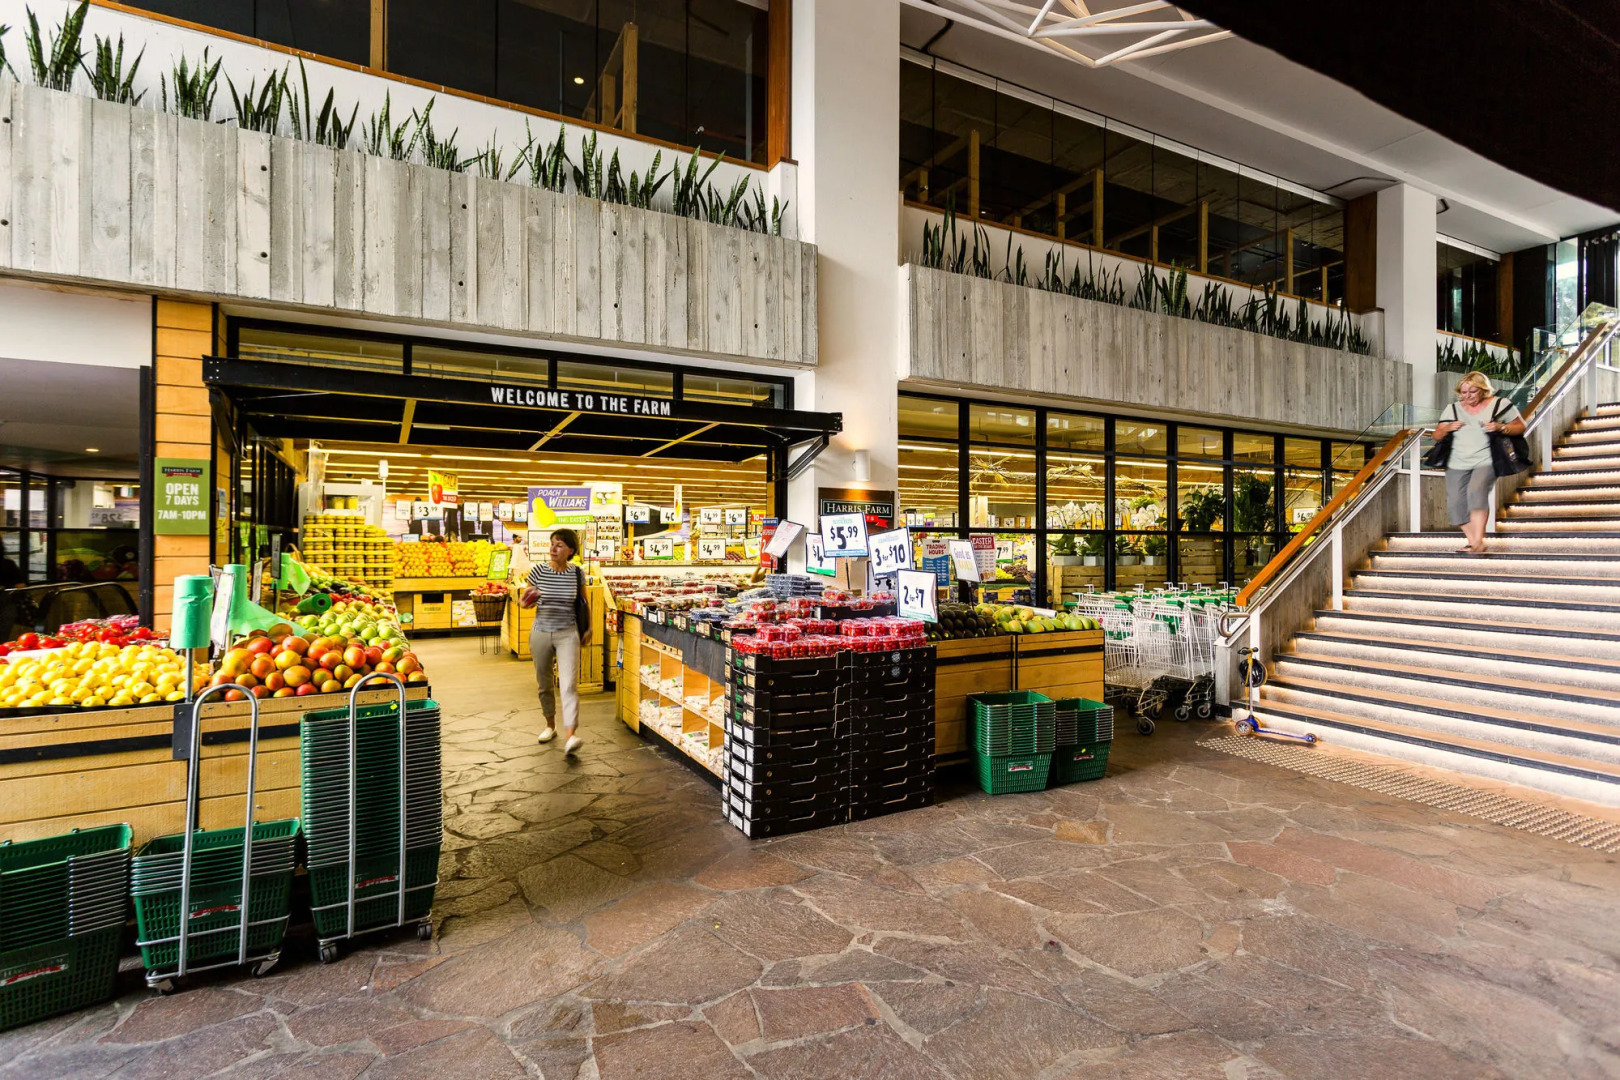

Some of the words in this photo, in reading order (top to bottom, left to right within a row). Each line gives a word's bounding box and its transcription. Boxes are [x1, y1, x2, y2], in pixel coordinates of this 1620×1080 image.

[491, 387, 570, 409] WELCOME
[575, 393, 594, 410] TO
[600, 396, 628, 413] THE
[634, 399, 671, 416] FARM
[166, 483, 199, 496] OPEN
[538, 489, 561, 497] POACH
[165, 495, 172, 506] 7
[174, 495, 199, 506] DAYS
[548, 496, 588, 508] WILLIAMS
[826, 503, 862, 513] HARRIS
[864, 504, 890, 514] FARM
[157, 510, 207, 520] 7AM-10PM
[830, 525, 858, 550] $5.99
[649, 544, 669, 556] $4.99
[702, 543, 720, 555] $4.99
[875, 548, 882, 567] 3
[889, 543, 906, 564] $10
[903, 585, 909, 605] 2
[915, 587, 925, 609] $7
